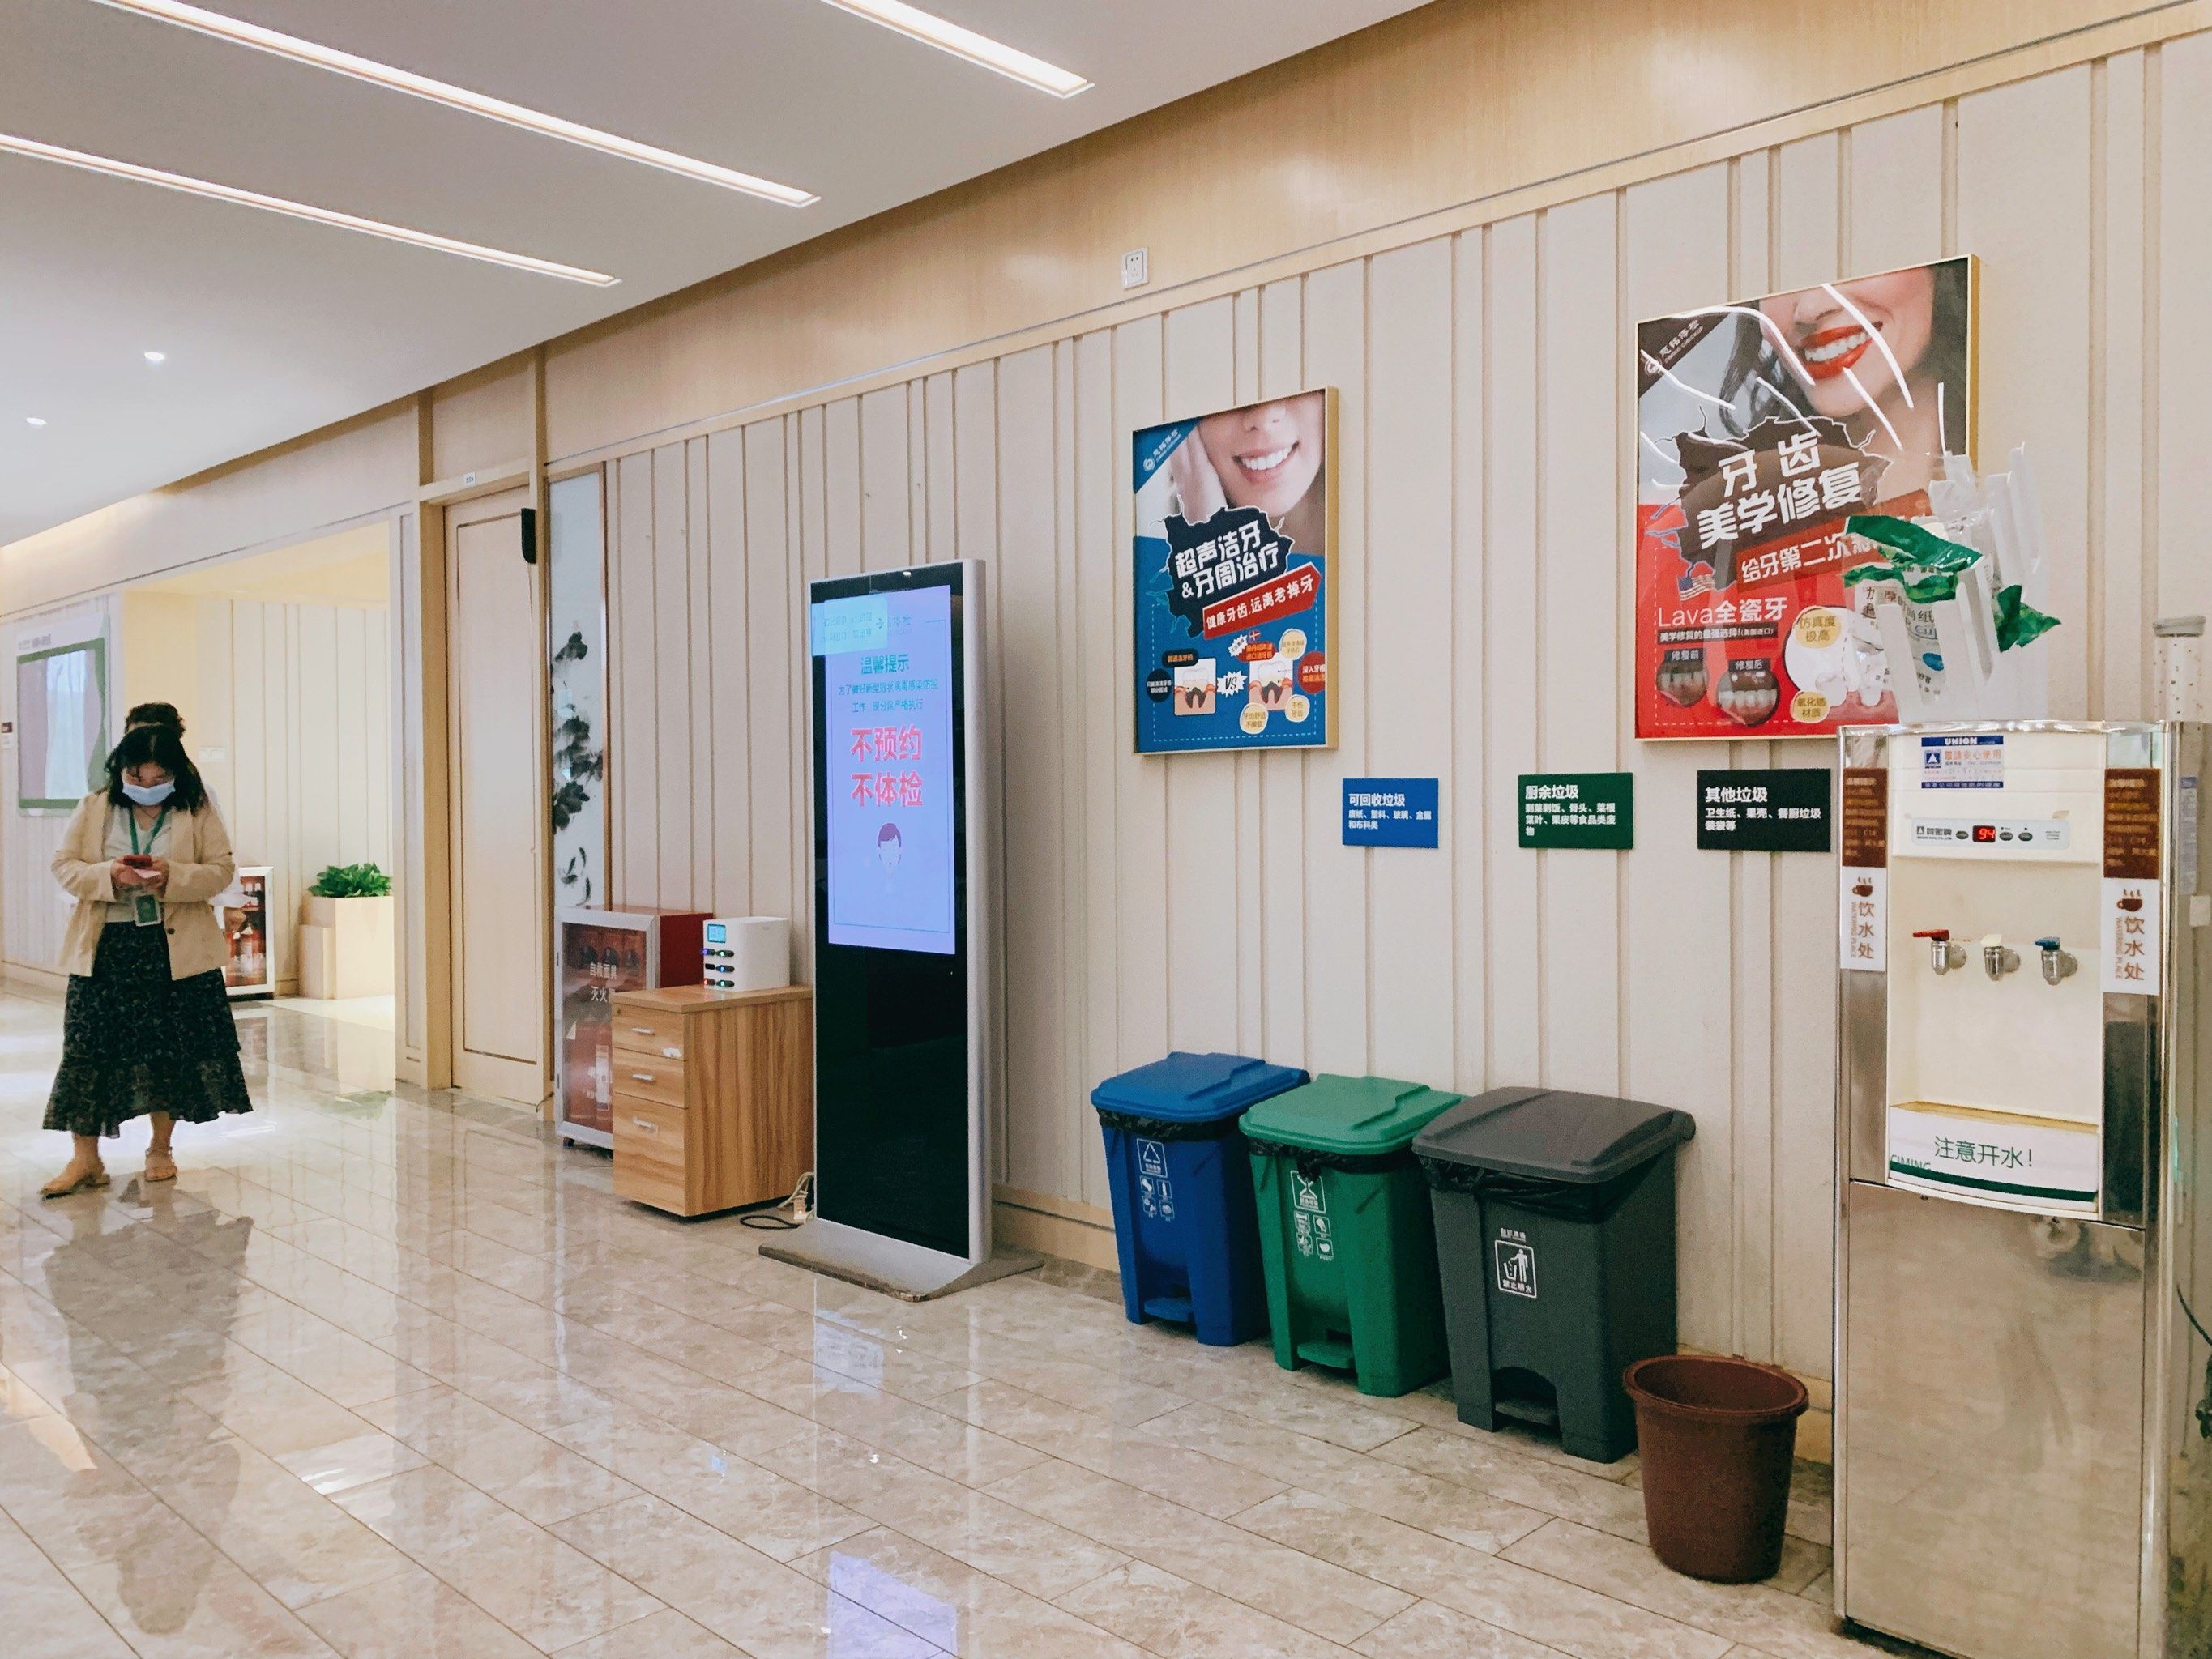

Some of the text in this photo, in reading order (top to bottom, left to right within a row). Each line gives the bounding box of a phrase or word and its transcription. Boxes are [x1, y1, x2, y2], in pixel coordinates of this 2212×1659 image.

[1697, 462, 1862, 550] 美学修复
[1175, 520, 1261, 578] 超声洁牙
[1741, 532, 1879, 583] 给牙第二次
[1800, 616, 1836, 629] 仿真度
[1805, 629, 1830, 642] 极高
[1672, 650, 1699, 660] 修复前
[861, 654, 909, 675] 温馨提示
[1736, 659, 1762, 670] 修复后
[1225, 676, 1237, 690] VS
[851, 724, 922, 762] 不预约
[1945, 736, 1977, 745] UNION
[851, 770, 923, 808] 不体检
[1525, 784, 1578, 800] 厨余垃圾
[1705, 787, 1768, 803] 其他垃圾
[1348, 793, 1405, 807] 可回收垃圾
[1526, 826, 1535, 836] 物
[1979, 828, 1995, 840] 94
[1858, 901, 1875, 959] 饮水处
[2124, 916, 2145, 981] 饮水处
[1934, 1135, 2033, 1169] 注意开水!
